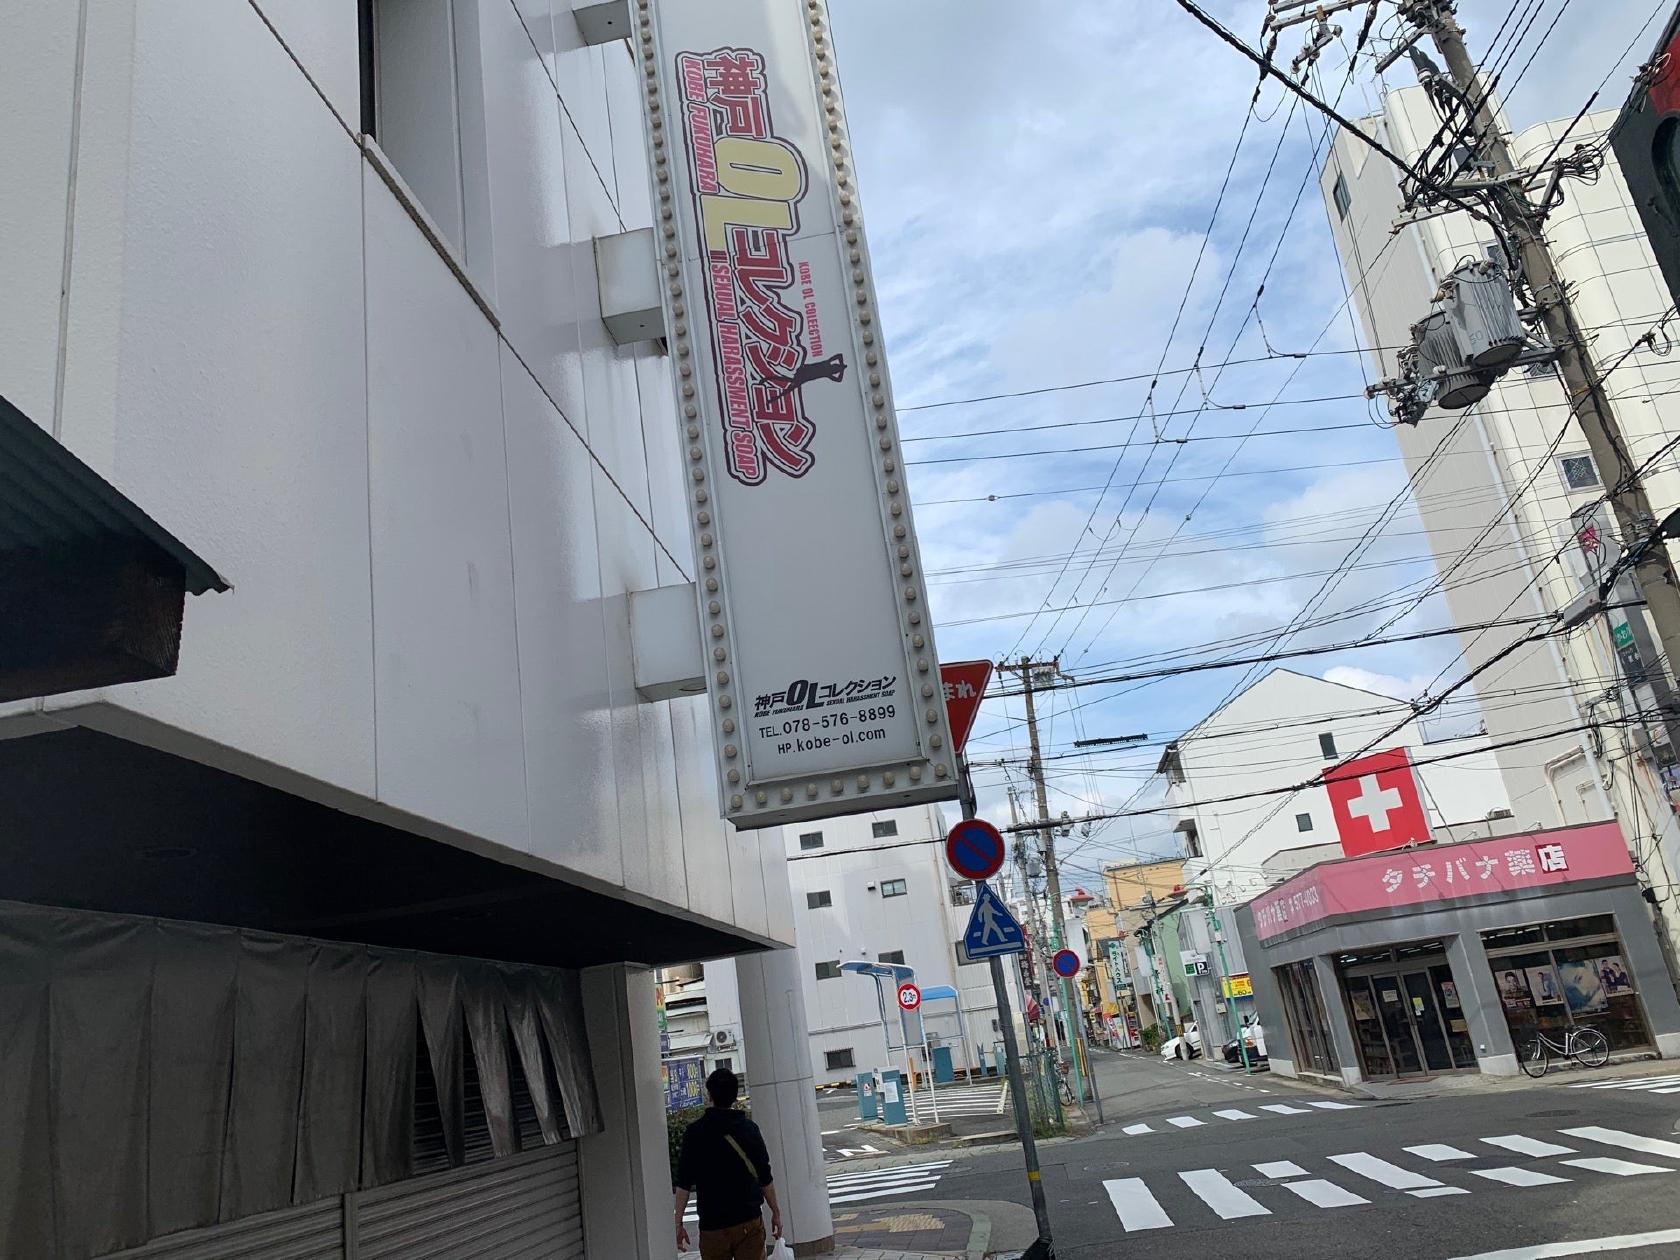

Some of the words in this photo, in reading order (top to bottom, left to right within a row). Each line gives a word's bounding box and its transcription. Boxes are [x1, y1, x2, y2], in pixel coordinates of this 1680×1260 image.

[683, 57, 706, 102] KOBE
[688, 102, 719, 194] FUKUHARA
[710, 263, 736, 321] SEXUAL
[797, 261, 811, 287] KOBE
[802, 287, 816, 300] OL
[717, 321, 751, 429] HARASSMENT
[731, 430, 759, 478] SOAP
[1382, 843, 1569, 893] タチバナ薬店
